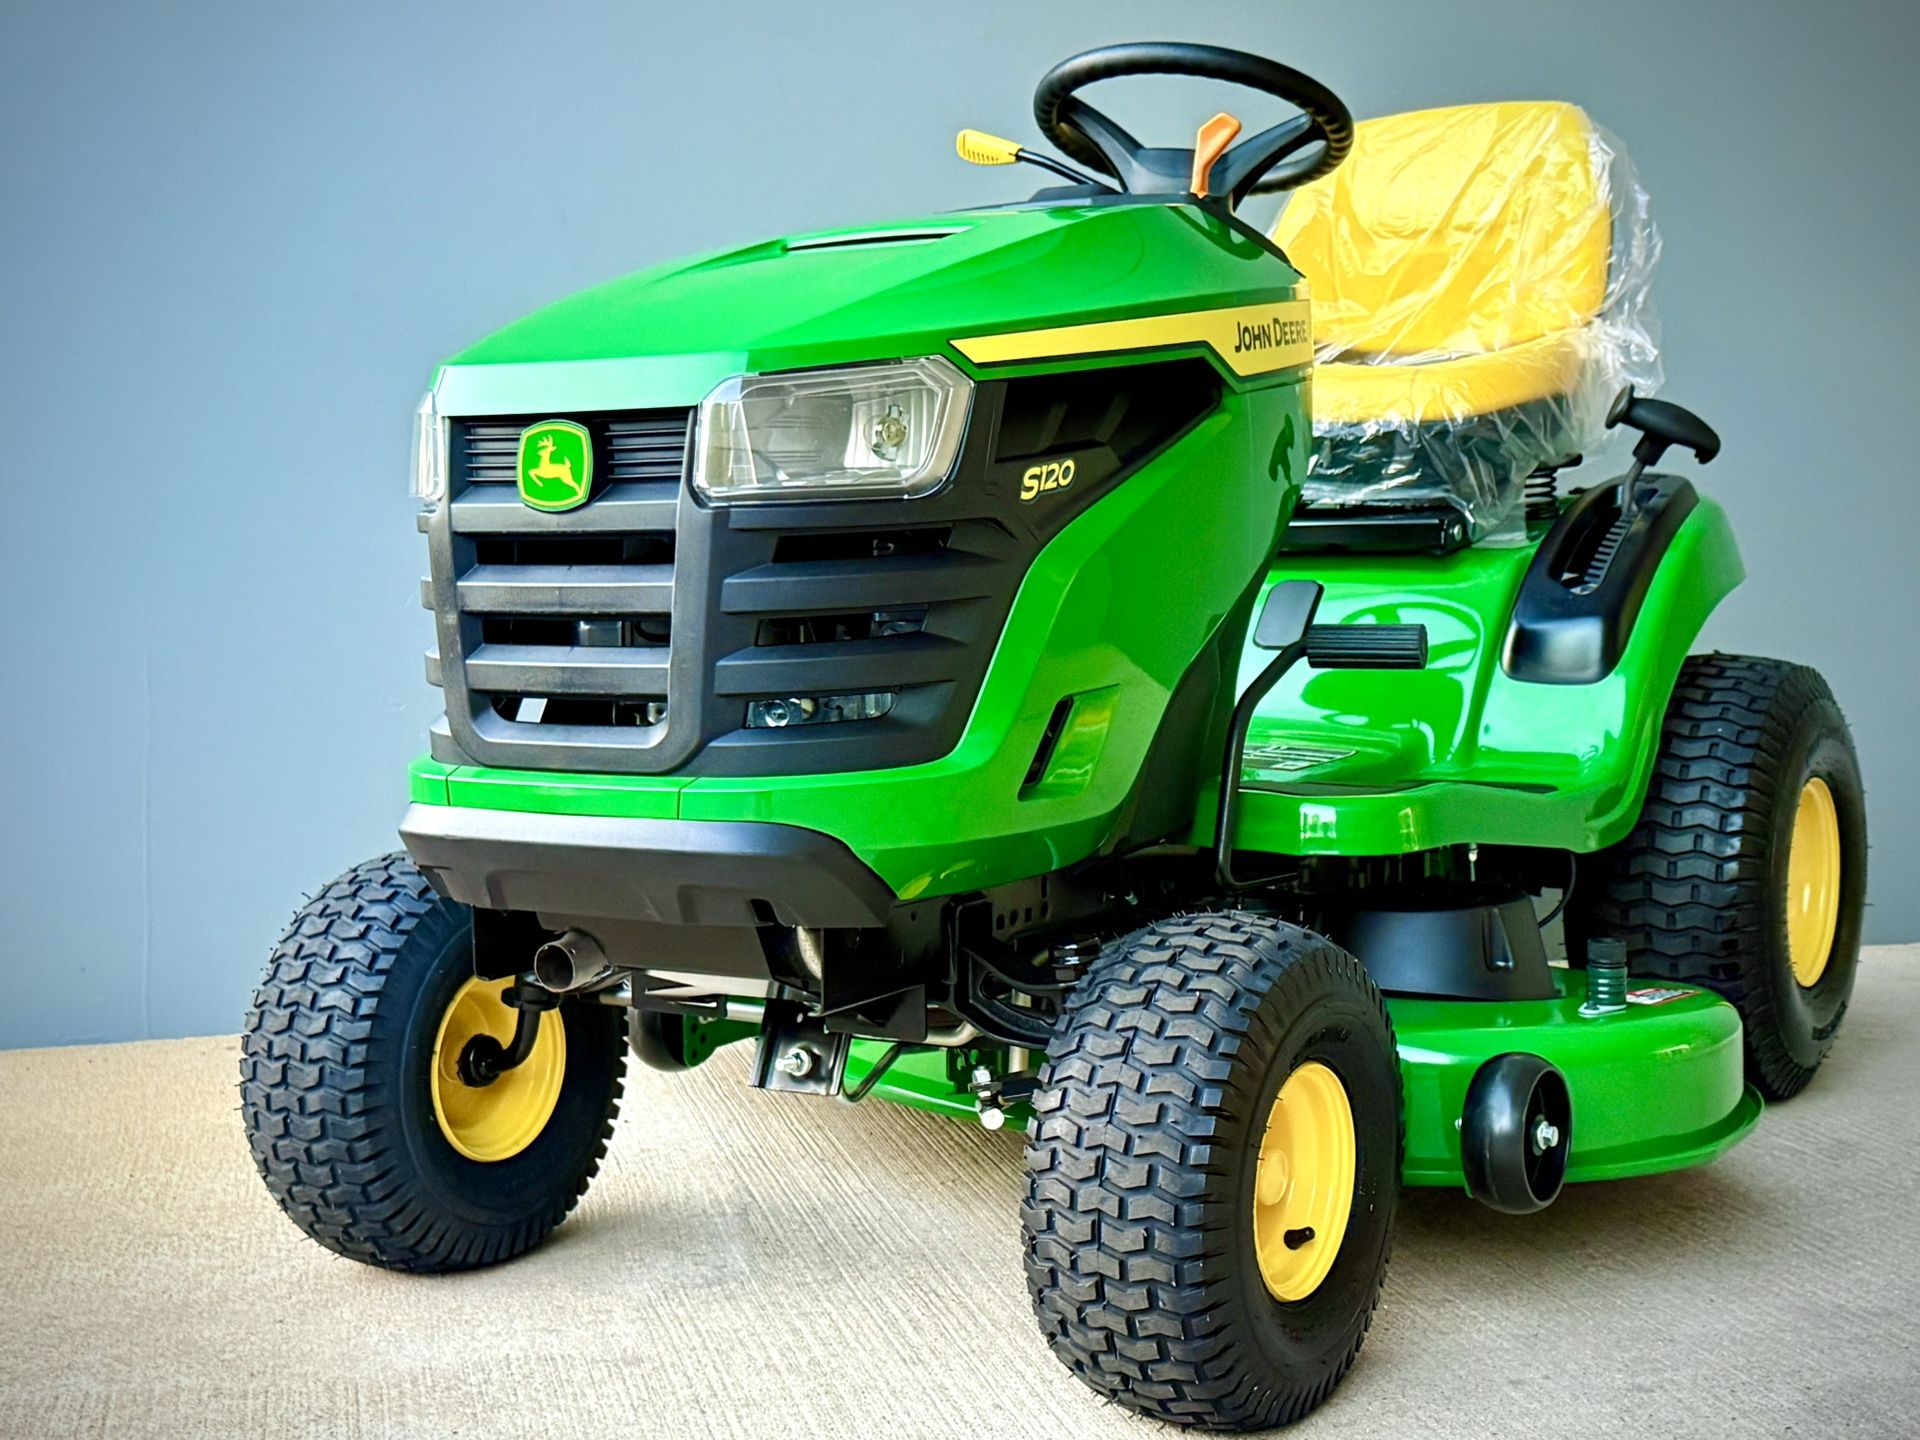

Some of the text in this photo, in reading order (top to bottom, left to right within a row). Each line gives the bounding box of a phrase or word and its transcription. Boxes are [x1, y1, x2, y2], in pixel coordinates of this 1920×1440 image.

[1234, 317, 1308, 353] JOHN DEERE
[1020, 459, 1075, 500] S120
